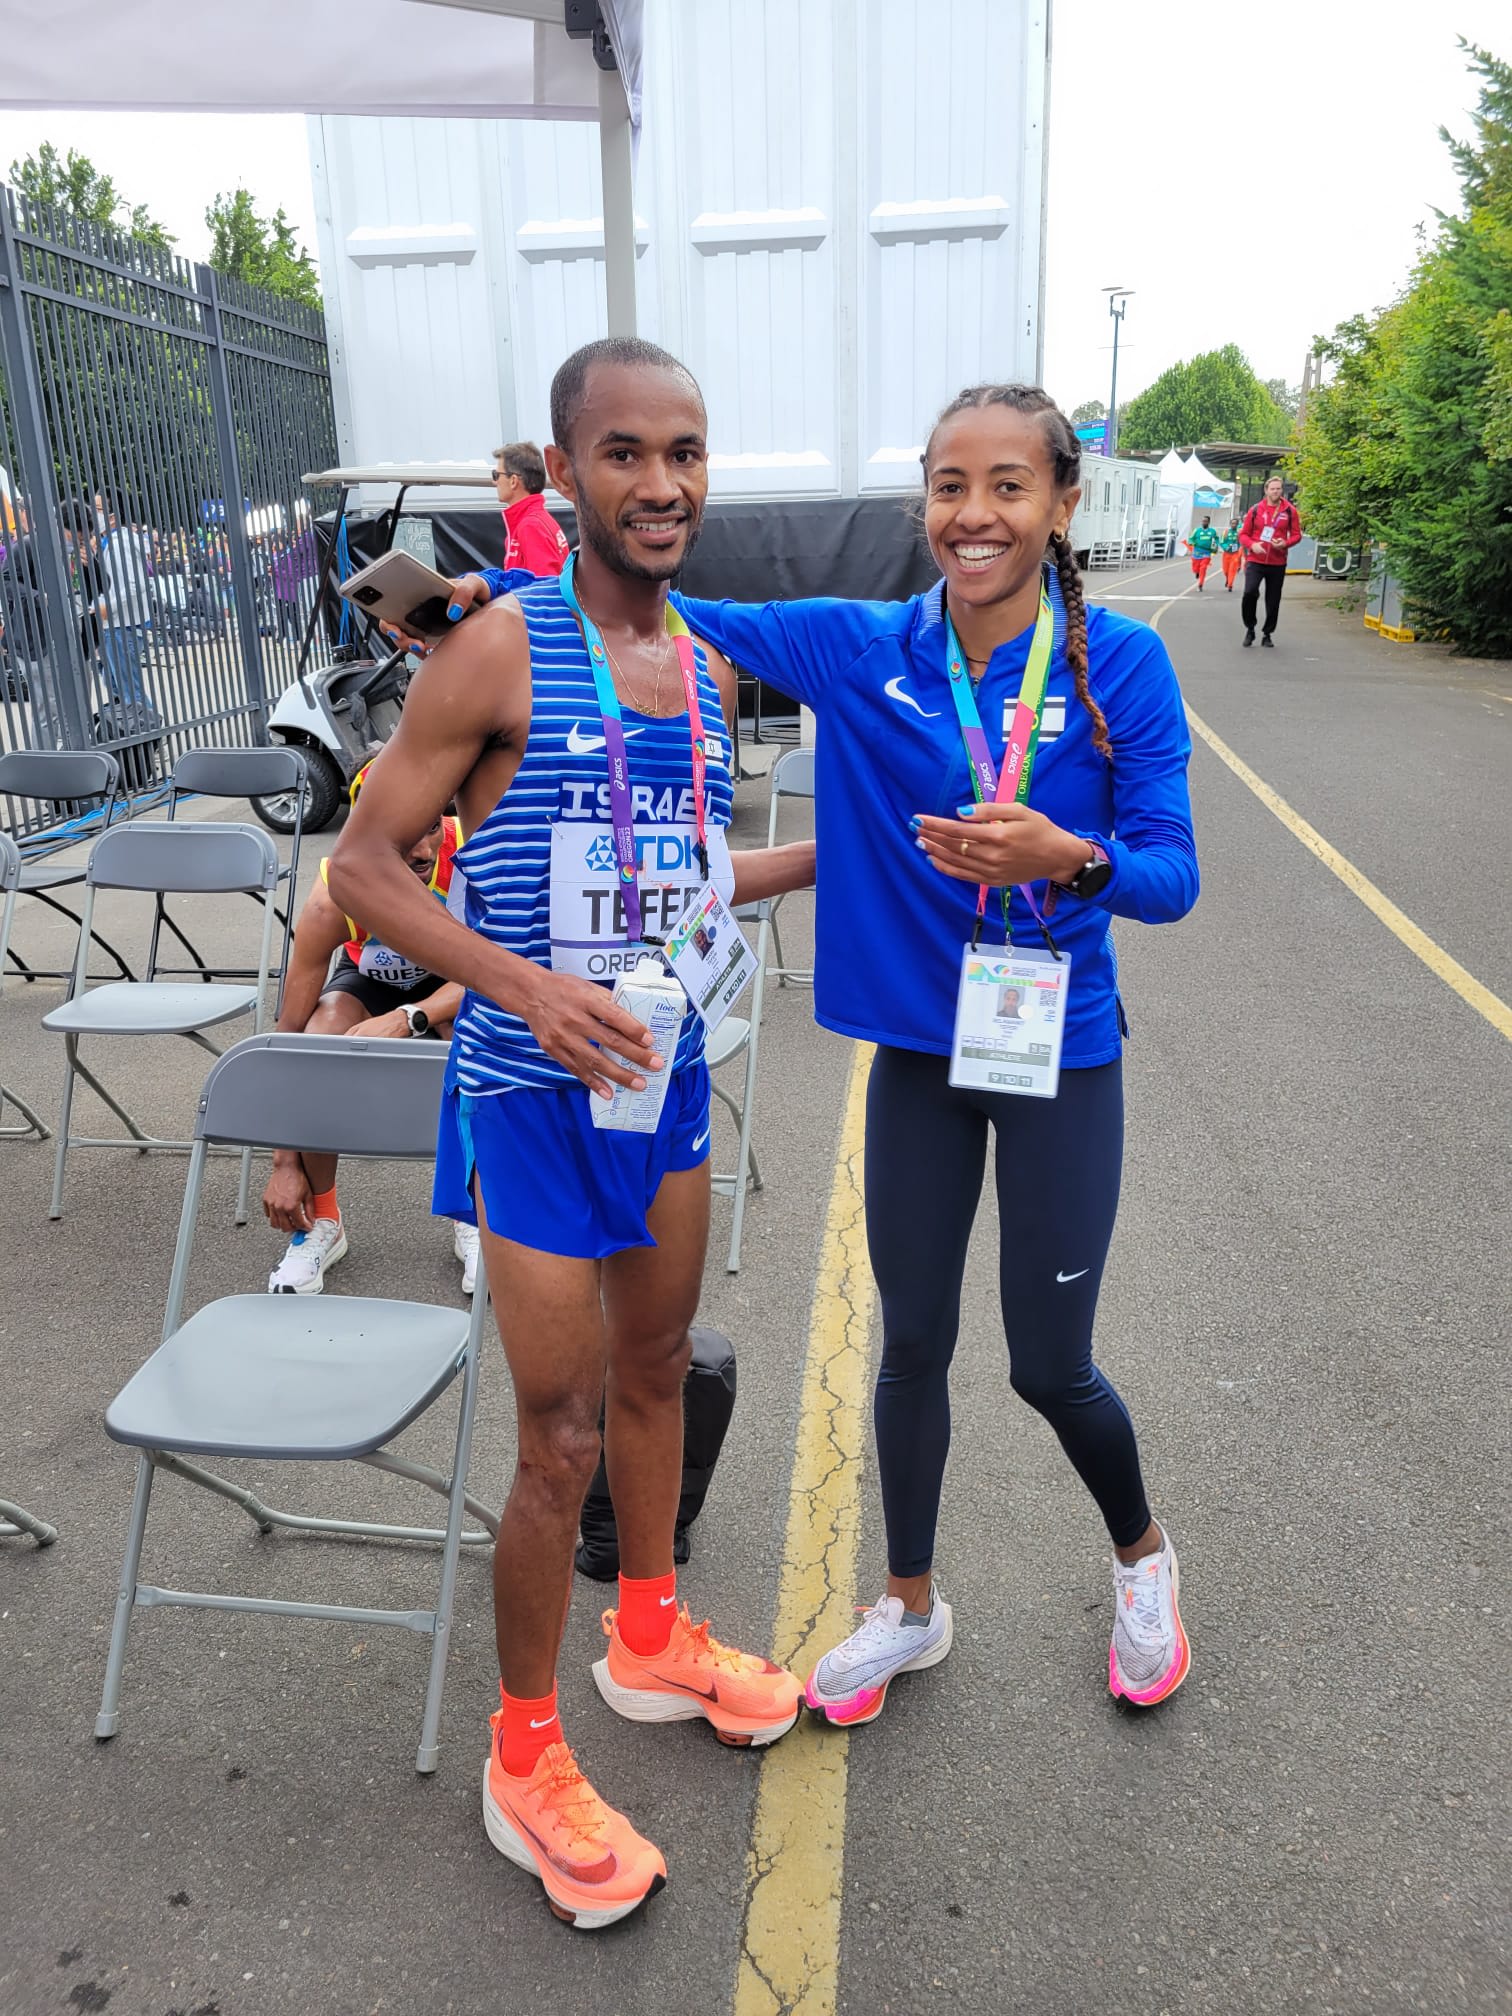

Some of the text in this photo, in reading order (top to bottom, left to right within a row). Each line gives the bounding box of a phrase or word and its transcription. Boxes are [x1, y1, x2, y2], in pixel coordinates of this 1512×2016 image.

[614, 757, 624, 786] asics
[1008, 747, 1021, 775] asics
[980, 763, 994, 788] asics
[561, 782, 714, 824] ISRAEL
